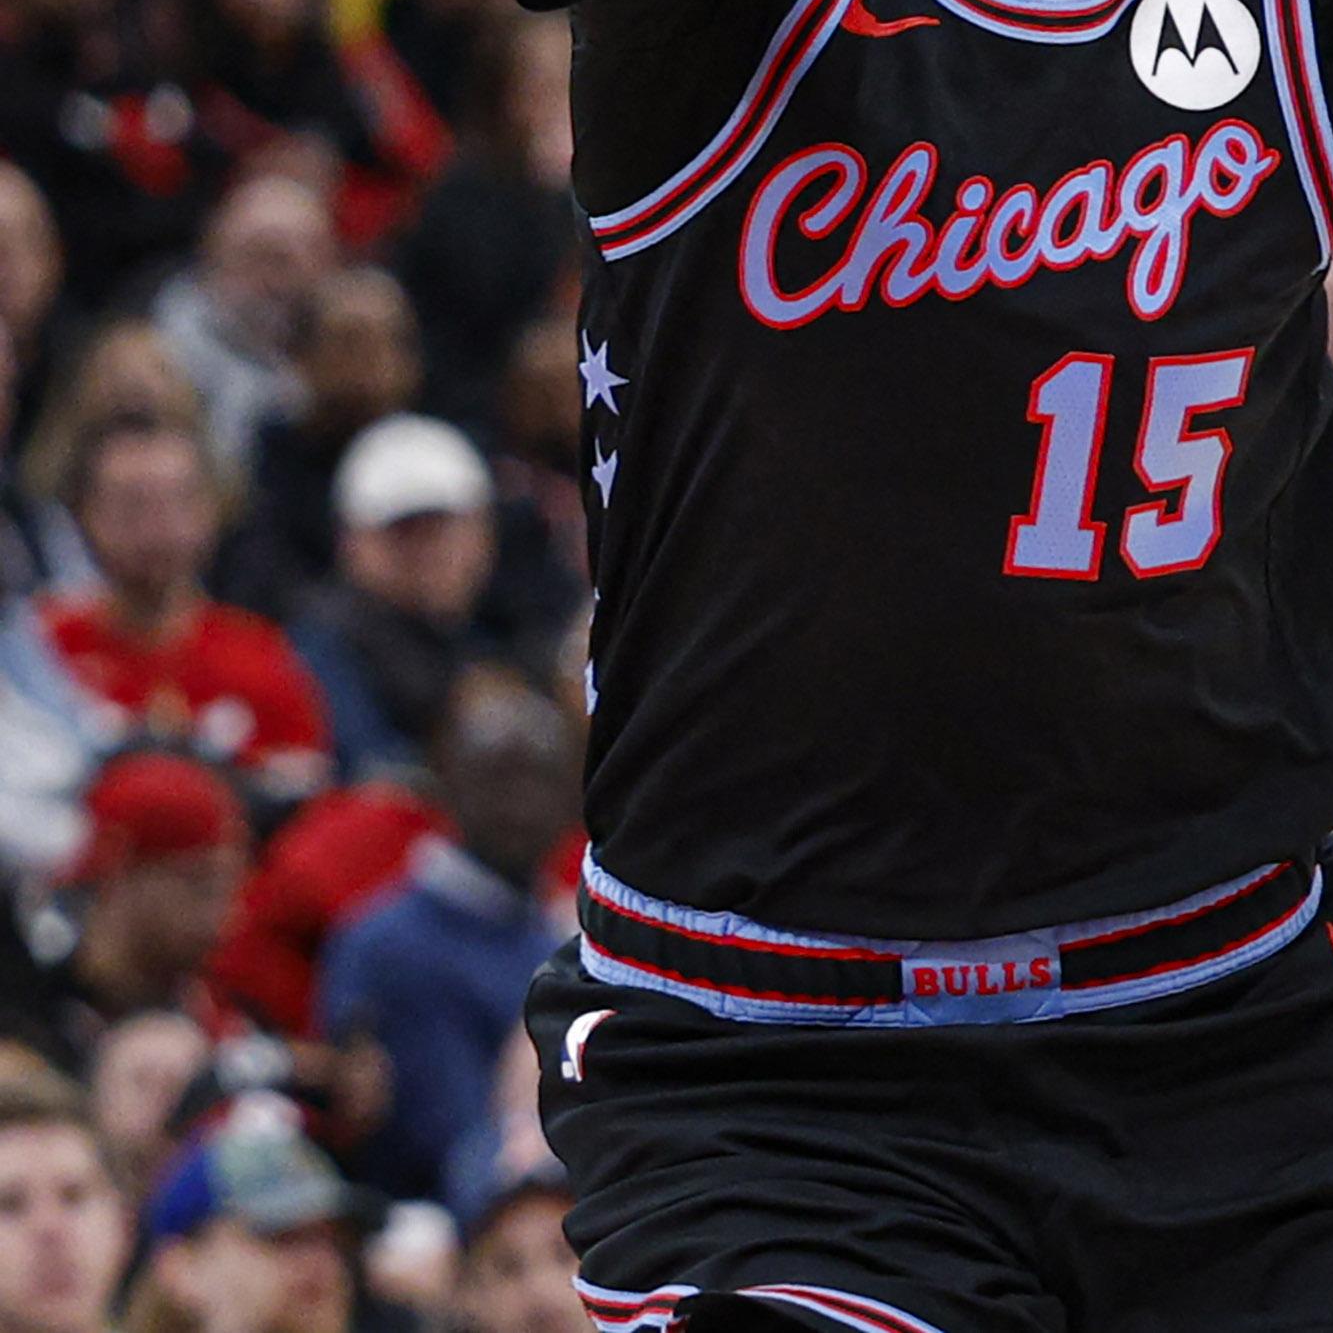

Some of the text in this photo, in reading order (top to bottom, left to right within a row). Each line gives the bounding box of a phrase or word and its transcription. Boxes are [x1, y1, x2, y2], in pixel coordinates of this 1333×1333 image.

[738, 118, 1281, 331] Chicago
[1003, 346, 1256, 582] 15
[912, 957, 1053, 997] BULLS
